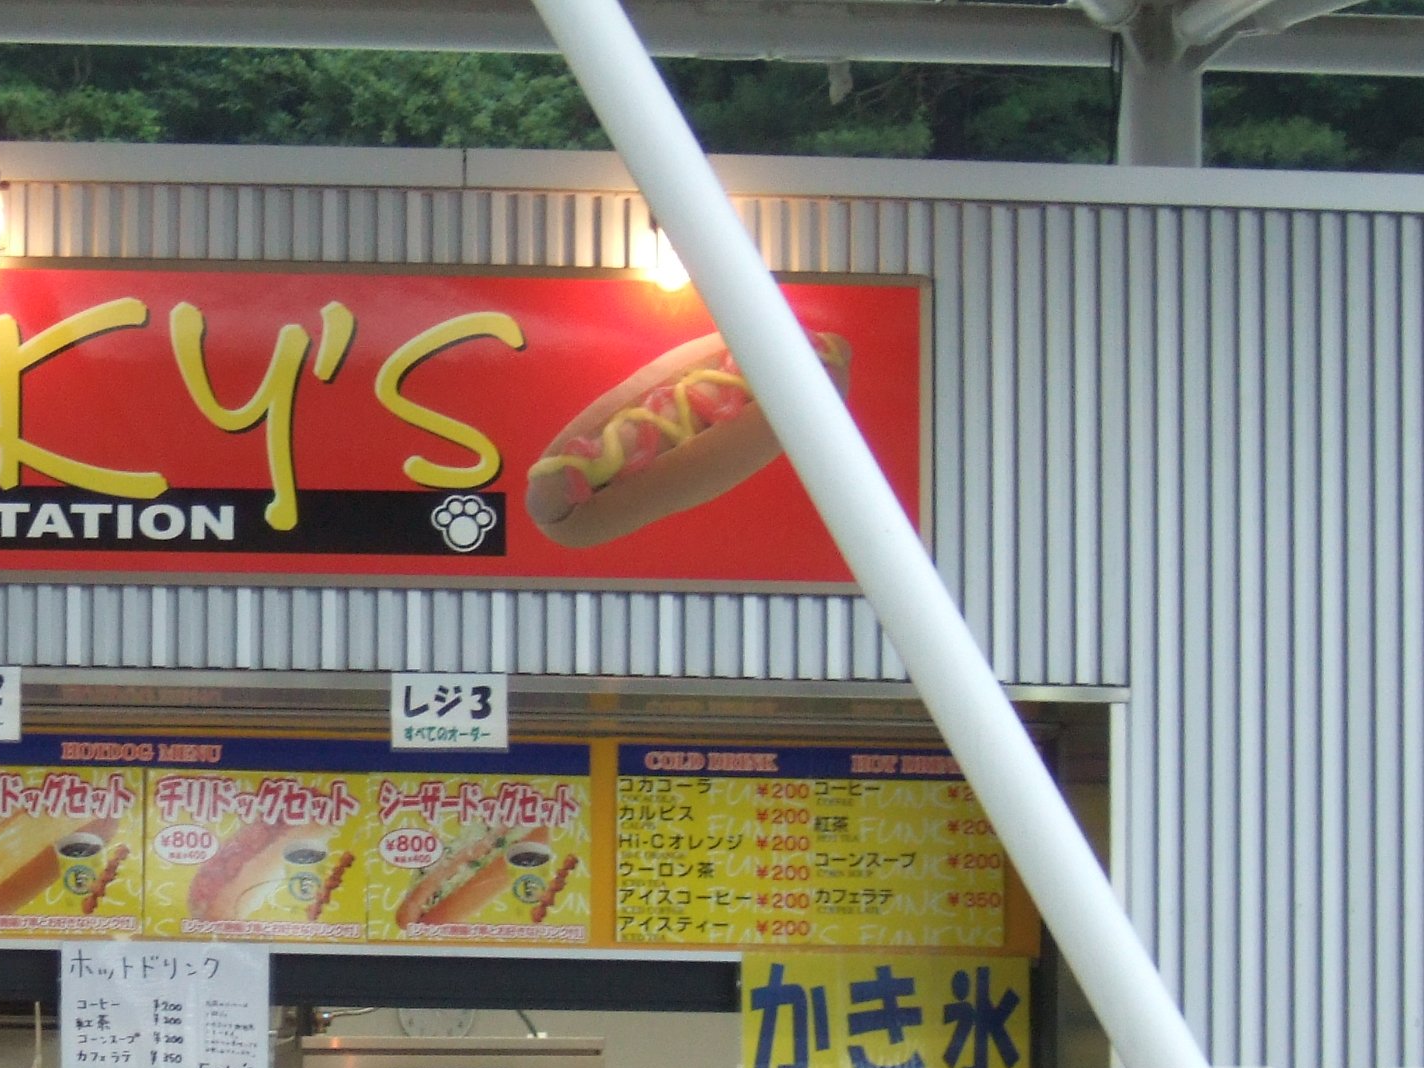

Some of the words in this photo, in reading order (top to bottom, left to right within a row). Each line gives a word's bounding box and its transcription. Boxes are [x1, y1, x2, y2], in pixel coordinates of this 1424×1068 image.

[403, 685, 492, 719] レジ3
[404, 726, 491, 743] すべてのオーダー
[618, 778, 712, 793] コカコーラ
[756, 783, 811, 799] ¥200
[815, 782, 881, 796] コーヒー
[155, 775, 361, 824] チリドッグセット
[378, 779, 581, 827] シーザードッグセット
[756, 808, 811, 825] ¥200
[161, 831, 212, 849] ¥800
[385, 835, 436, 853] ¥800
[756, 836, 811, 852] ¥200
[815, 852, 917, 868] コーンスープ
[948, 854, 1001, 870] ¥200
[618, 862, 715, 879] ウーロン茶
[756, 865, 811, 881] ¥200
[618, 888, 753, 906] アイスコーヒー
[756, 893, 811, 909] ¥200
[815, 889, 894, 905] カフェラテ
[948, 892, 1001, 908] ¥350
[618, 916, 729, 933] アイスティー
[756, 920, 811, 936] ¥200
[69, 949, 220, 980] ホットドリンク
[77, 998, 120, 1010] コーヒー
[78, 1032, 140, 1044] コーンスープ
[78, 1050, 131, 1063] カフェラテ
